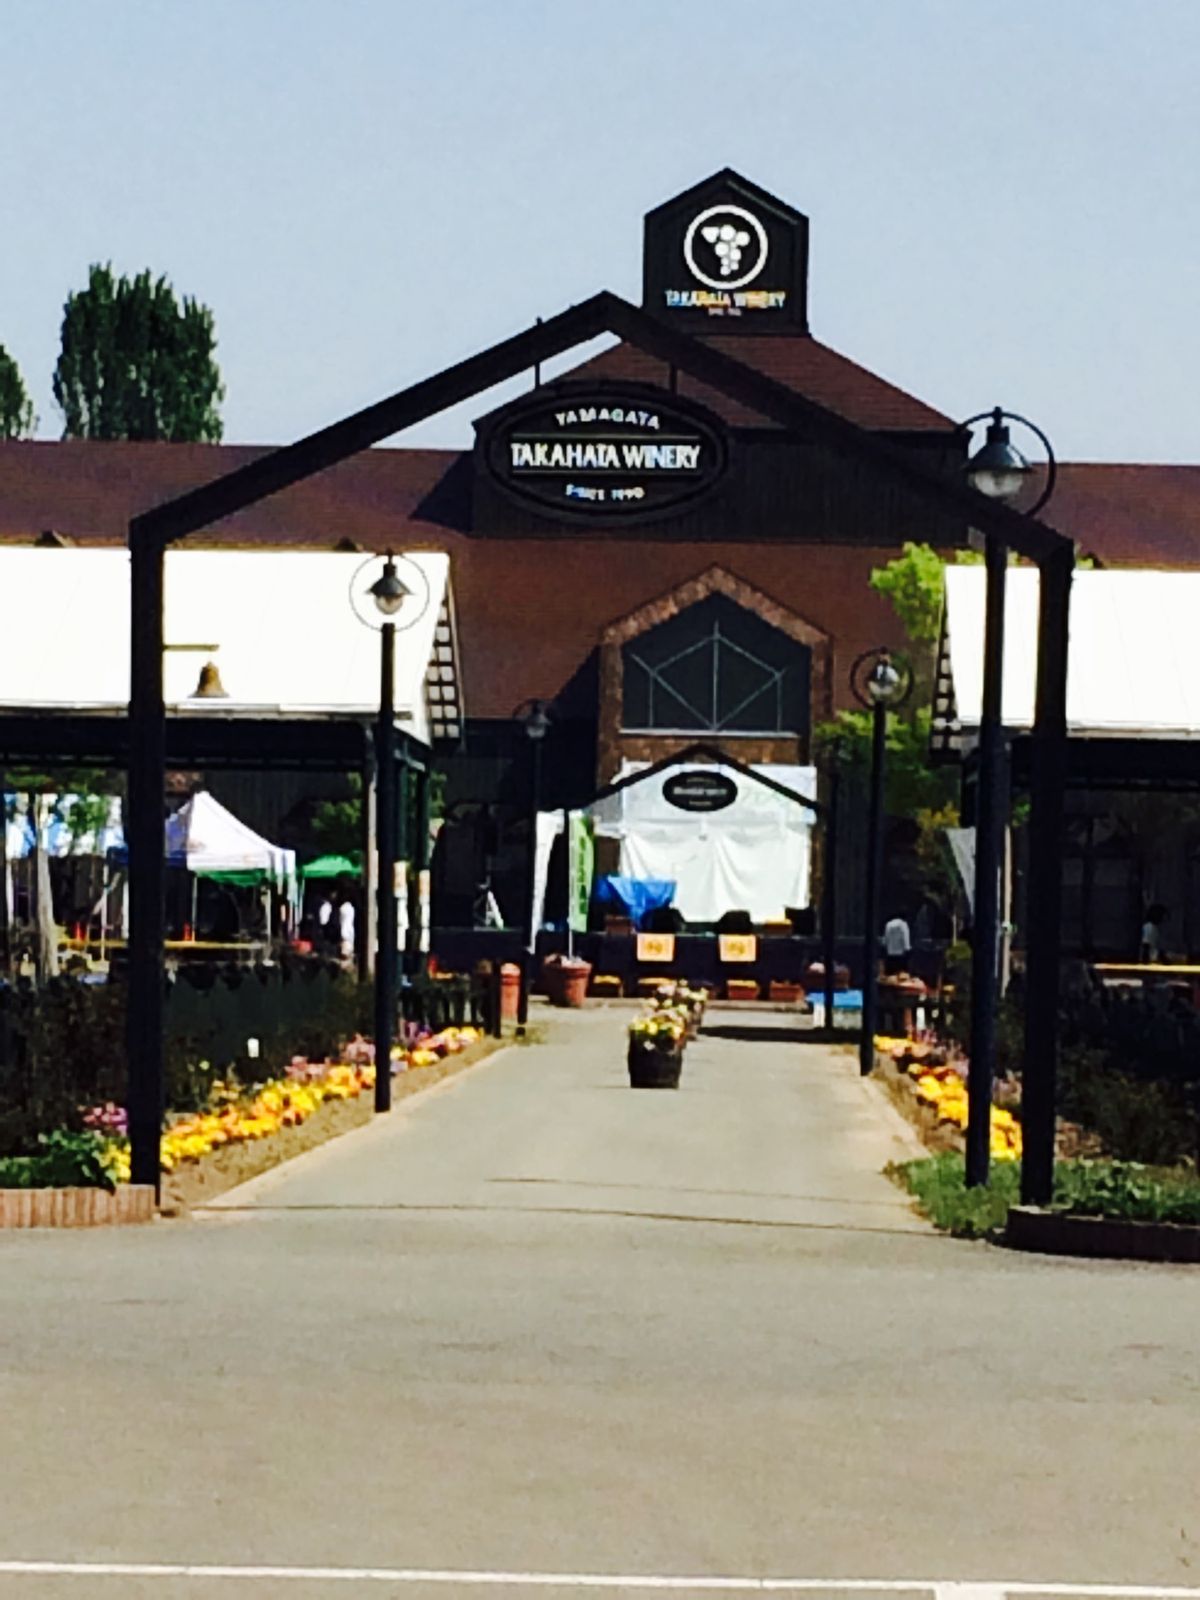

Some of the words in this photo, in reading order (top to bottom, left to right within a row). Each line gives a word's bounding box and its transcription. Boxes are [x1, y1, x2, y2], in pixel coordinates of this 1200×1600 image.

[555, 407, 660, 430] YAMAGATA
[511, 443, 620, 468] TAKAHATA
[622, 444, 700, 468] WINERY
